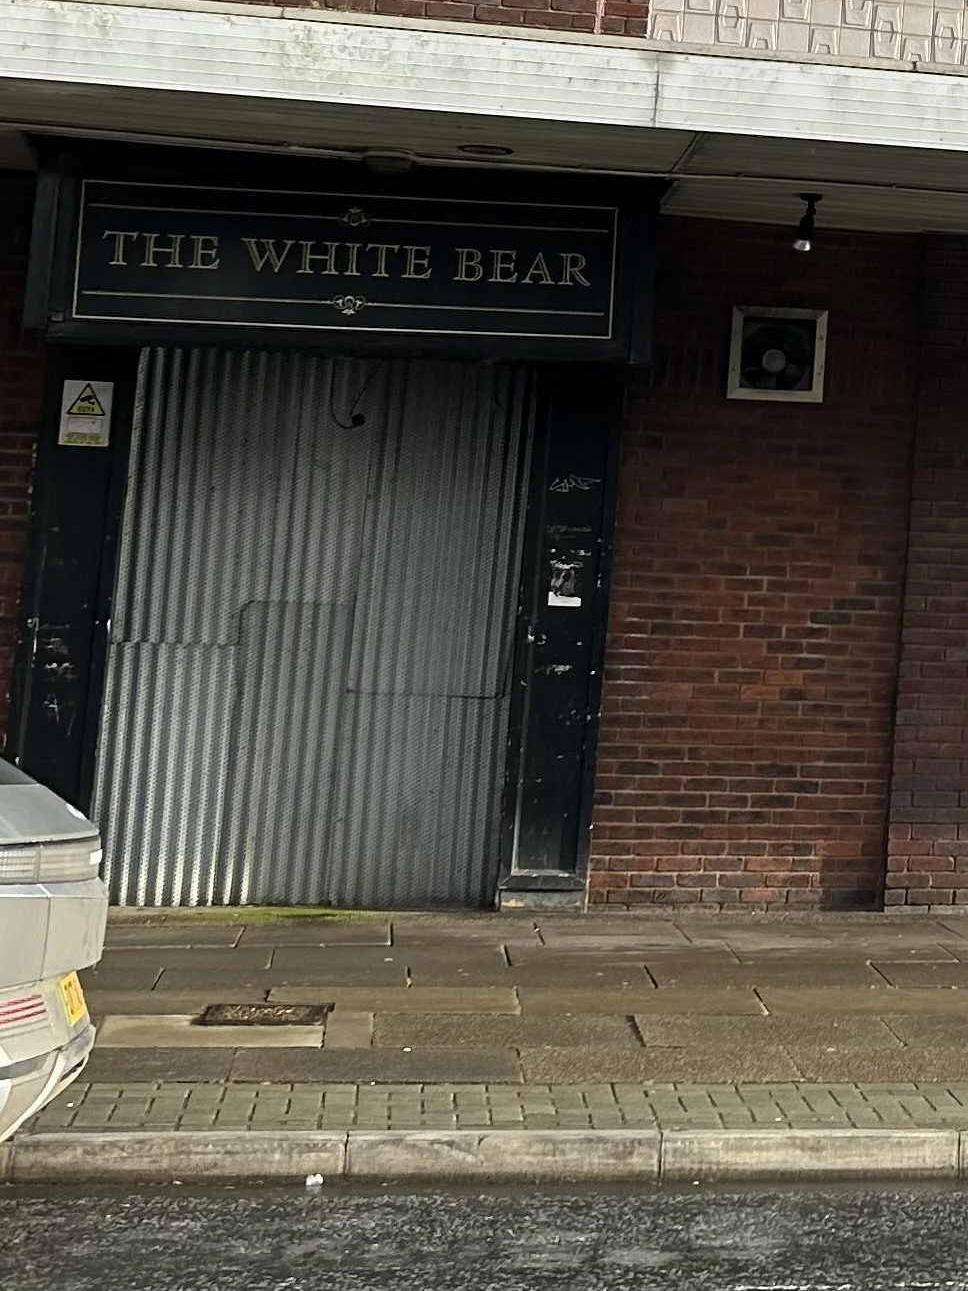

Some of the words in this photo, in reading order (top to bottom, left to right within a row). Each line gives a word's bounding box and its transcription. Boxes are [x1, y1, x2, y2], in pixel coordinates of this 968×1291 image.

[102, 230, 221, 270] THE
[241, 237, 432, 280] WHITE
[453, 247, 591, 287] BEAR
